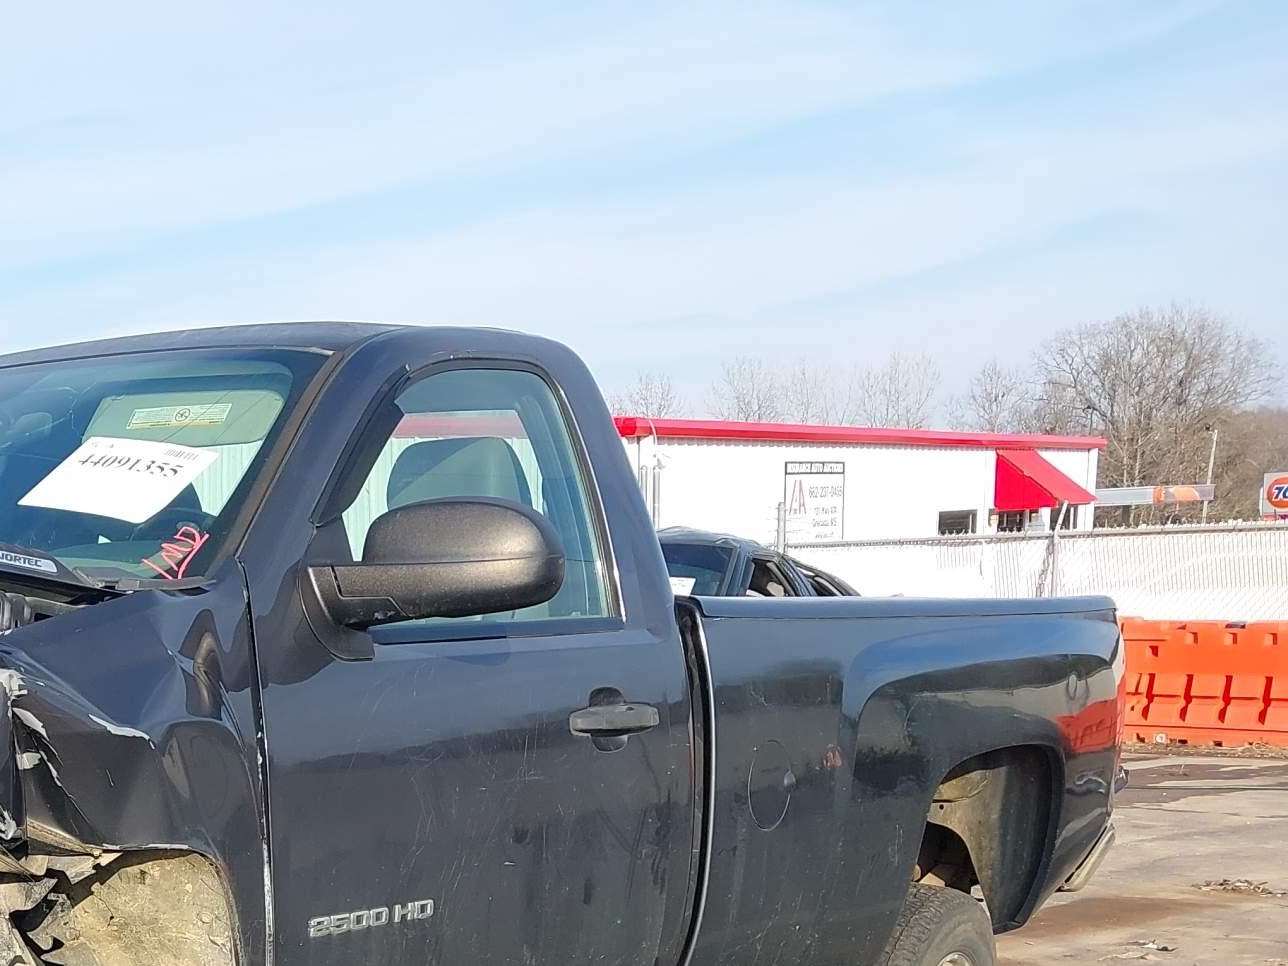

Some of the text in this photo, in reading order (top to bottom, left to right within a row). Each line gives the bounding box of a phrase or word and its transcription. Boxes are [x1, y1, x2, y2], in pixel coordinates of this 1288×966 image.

[78, 453, 185, 478] 44091355
[307, 899, 435, 937] 2500 HD
